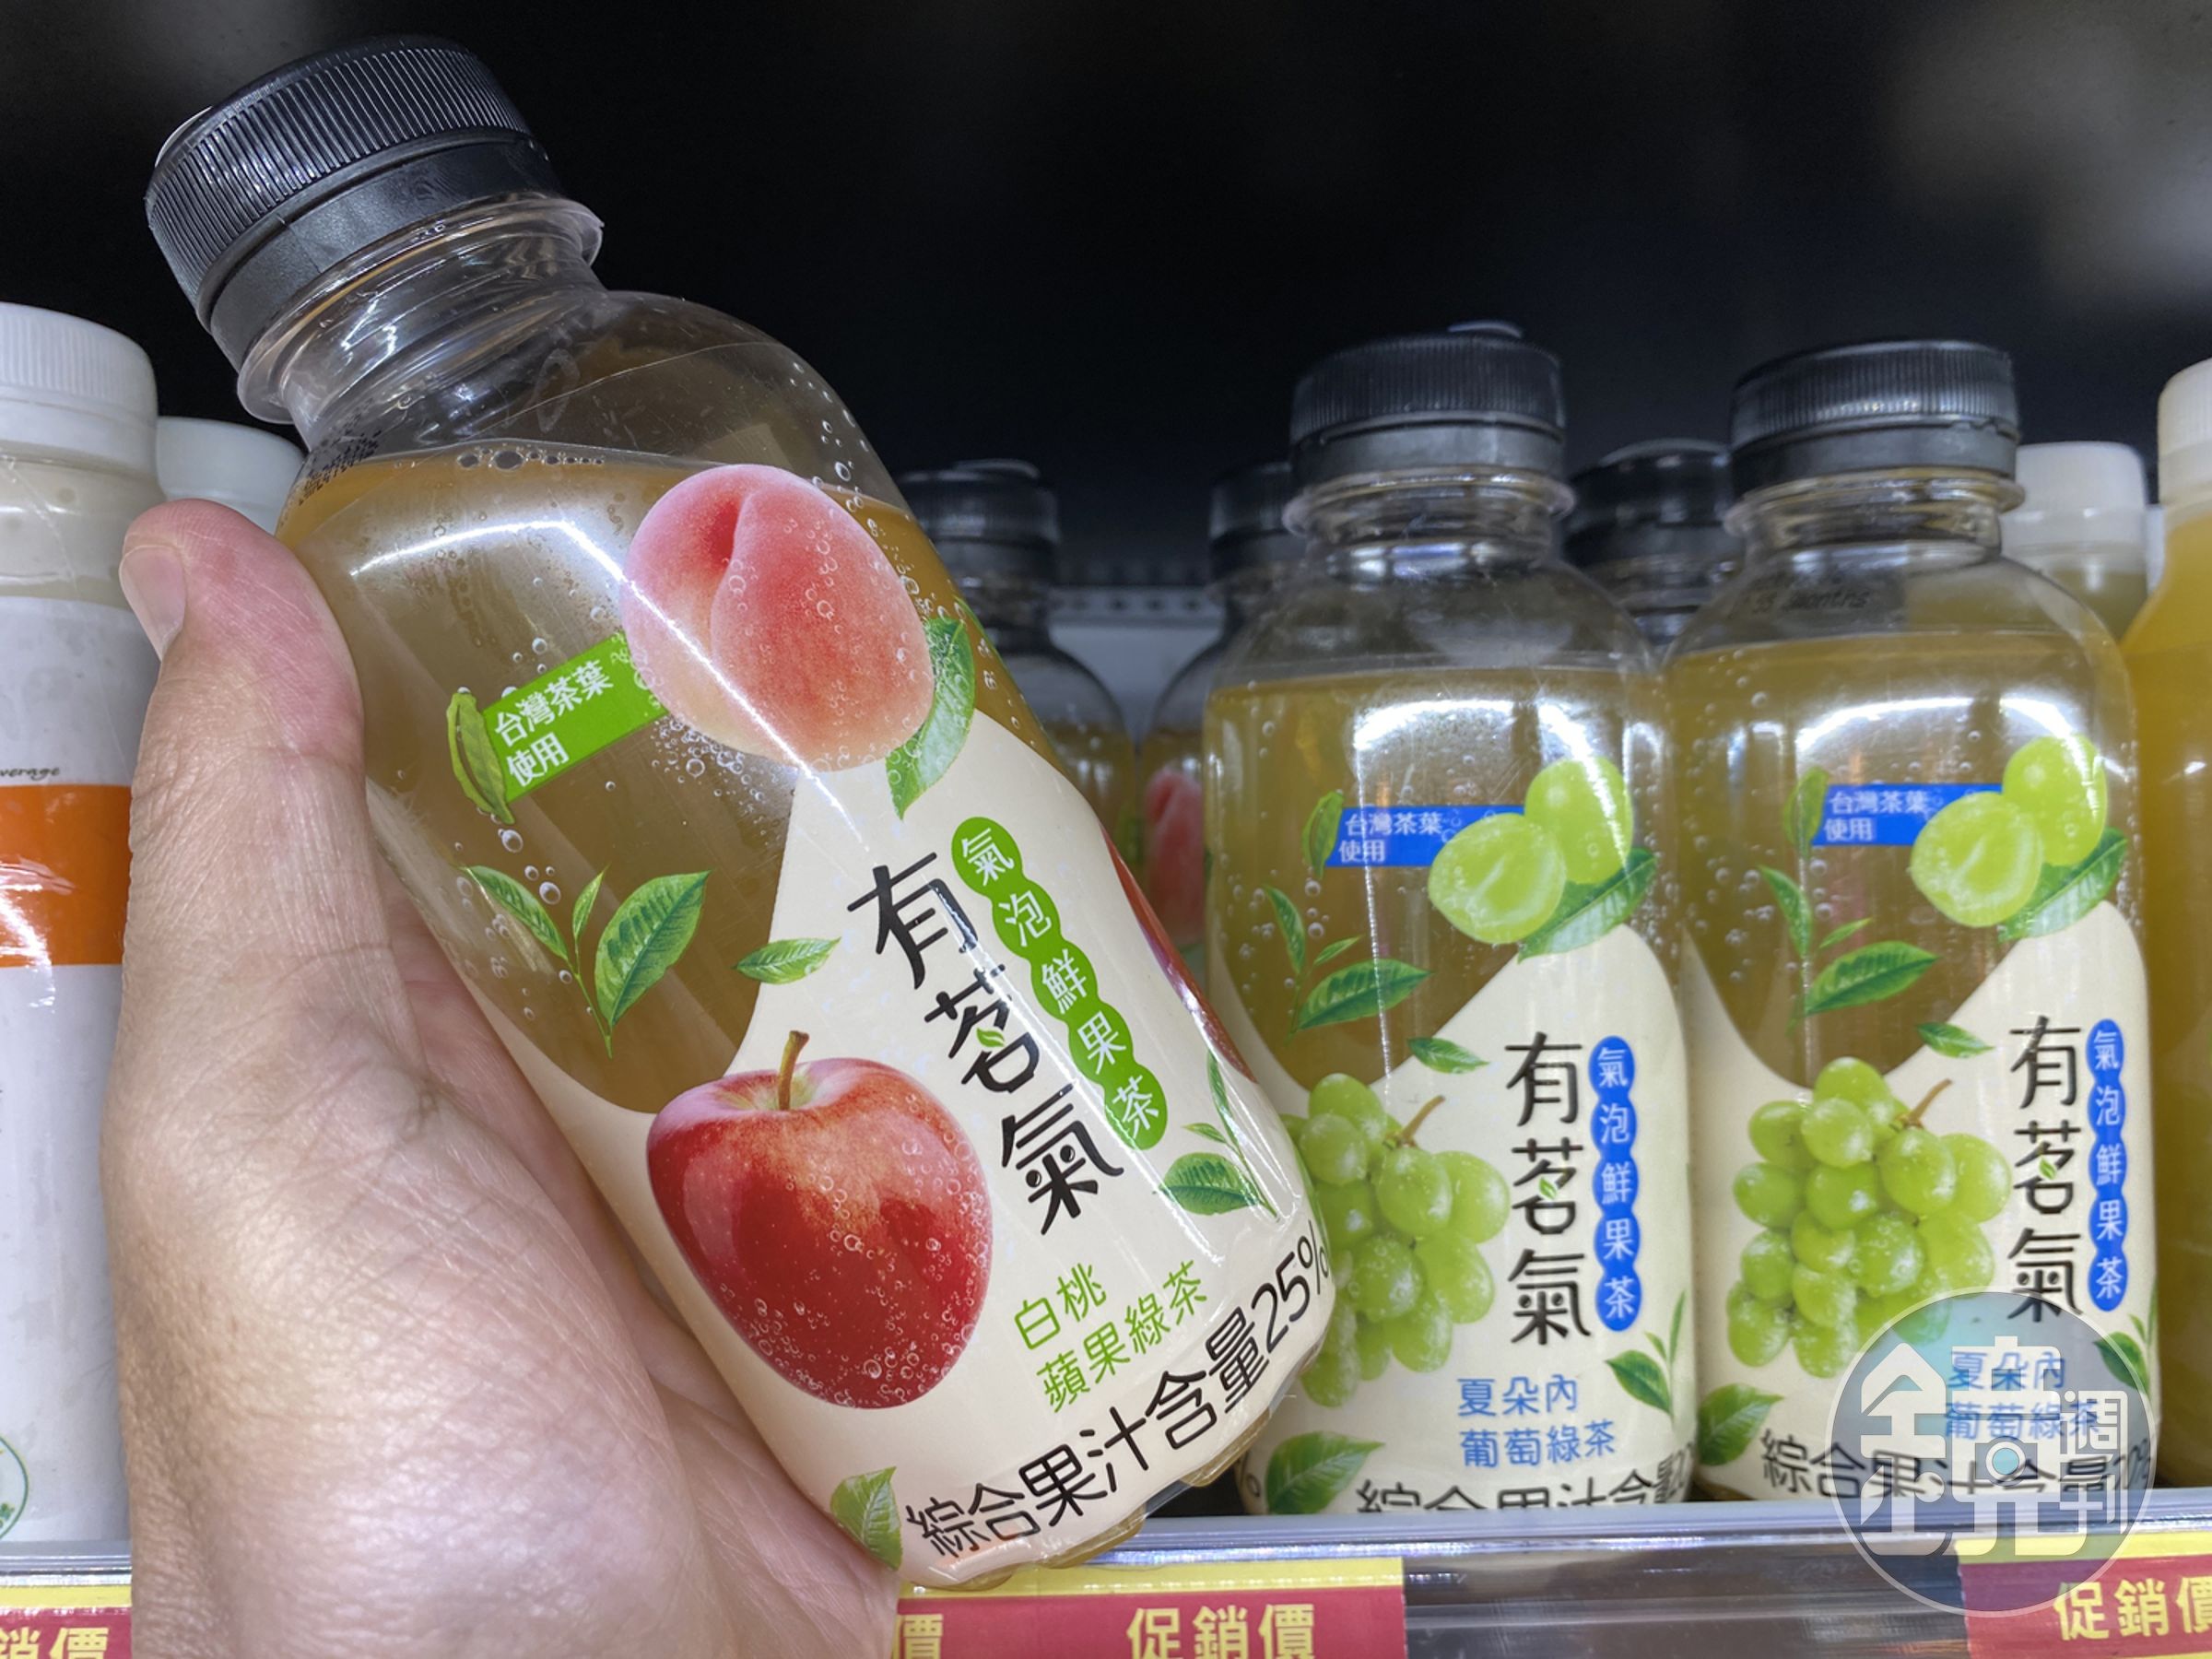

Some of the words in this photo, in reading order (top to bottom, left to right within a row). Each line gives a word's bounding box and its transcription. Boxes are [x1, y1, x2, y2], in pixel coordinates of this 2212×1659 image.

[495, 660, 614, 747] 台灣茶葉
[506, 733, 569, 787] 使用
[1830, 789, 1928, 815] 台灣茶葉
[1338, 840, 1386, 864] 使用
[1345, 812, 1443, 837] 台灣茶葉
[1825, 818, 1873, 842] 使用
[961, 828, 1159, 1139] 氣泡鮮果茶
[847, 852, 1124, 1235] 有茗氣
[1505, 1031, 1591, 1346] 有茗氣
[1597, 1047, 1634, 1319] 氣泡鮮果茶
[2007, 1015, 2083, 1324] 有茗氣
[2093, 1030, 2124, 1300] 氣泡鮮果茶
[1014, 1263, 1106, 1351] 白桃
[1037, 1260, 1207, 1414] 蘋果綠茶
[907, 1219, 1329, 1558] 綜合果汁含量25%
[1456, 1374, 1579, 1418] 夏朵內
[1459, 1419, 1616, 1469] 葡萄綠茶
[1126, 1604, 1314, 1659] 促銷價
[2053, 1575, 2212, 1641] 促銷價
